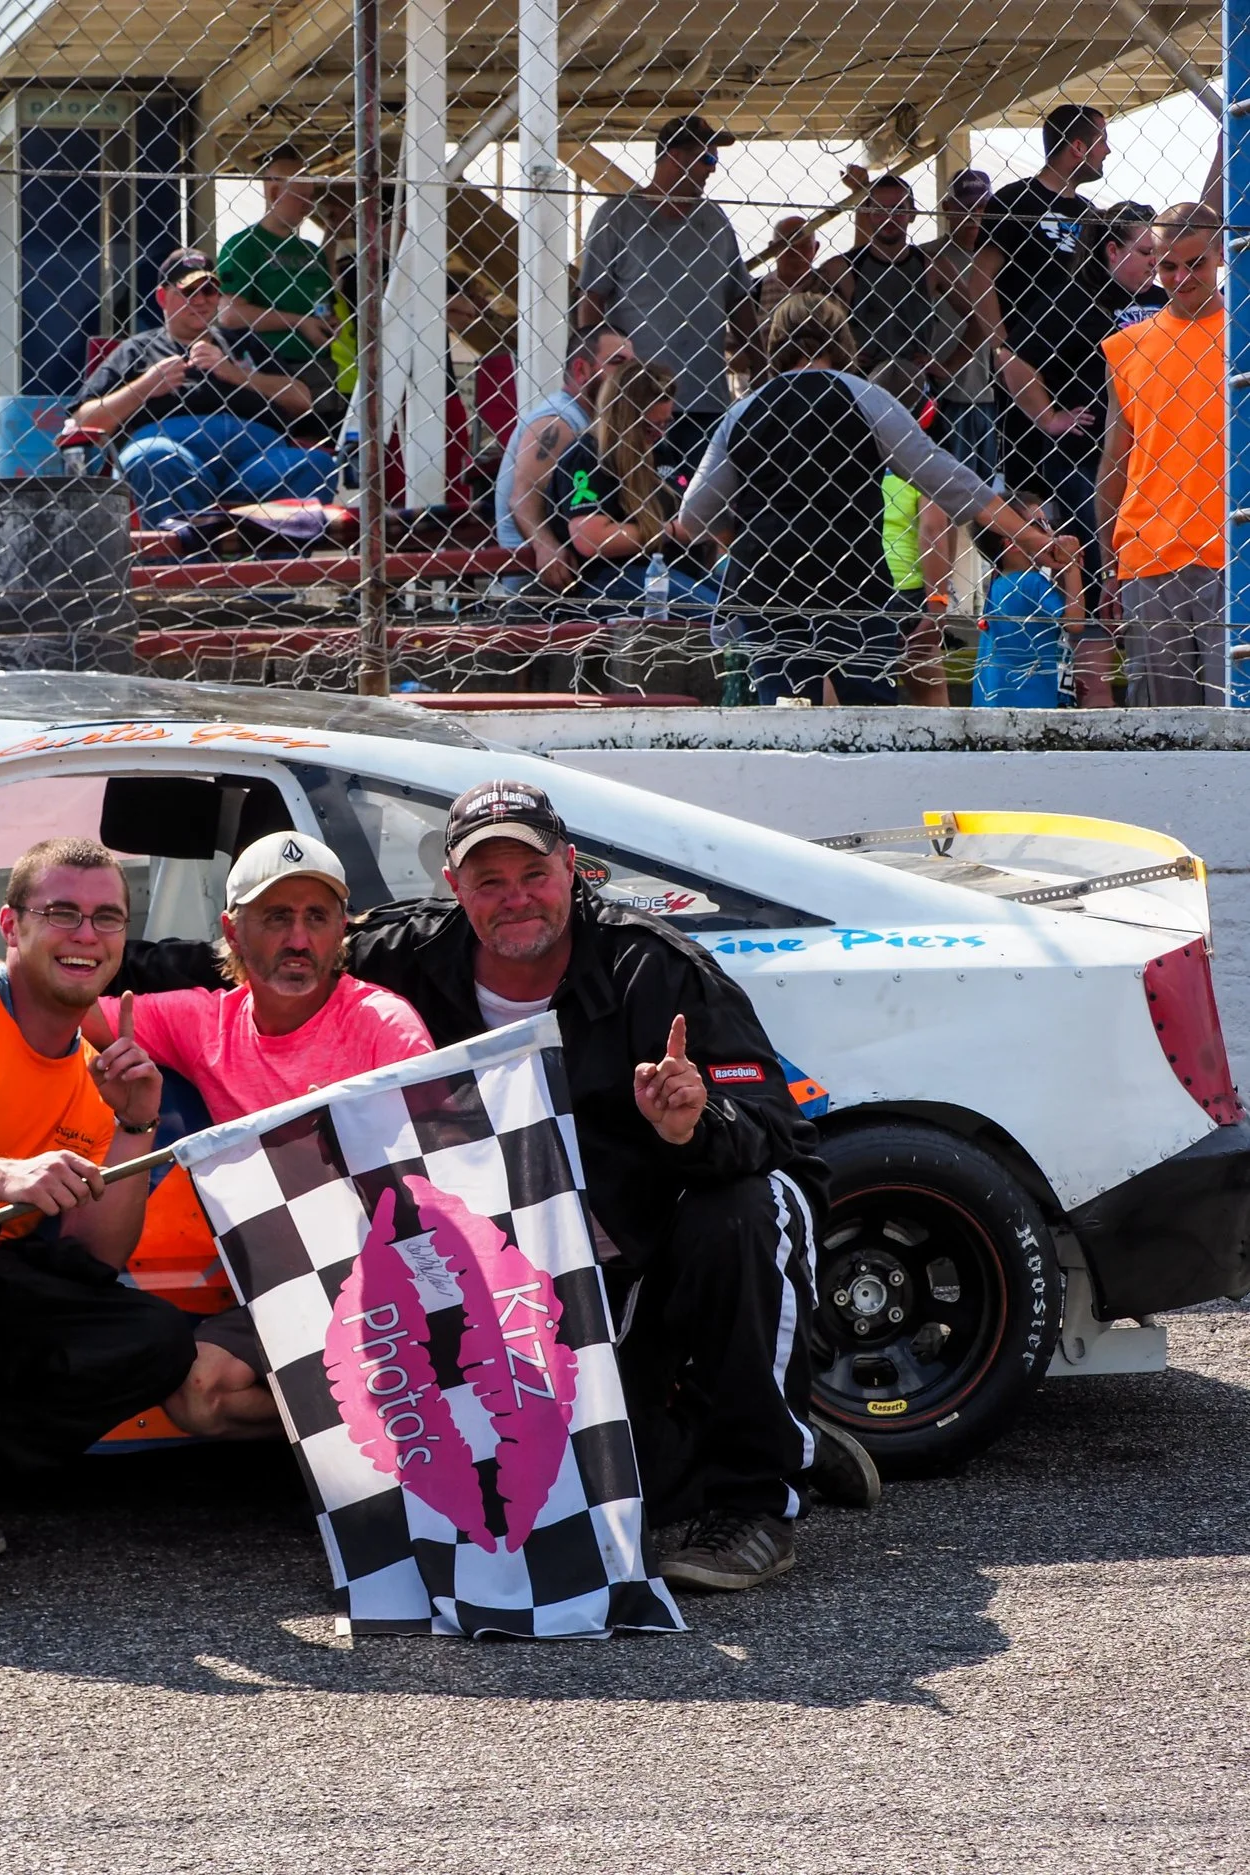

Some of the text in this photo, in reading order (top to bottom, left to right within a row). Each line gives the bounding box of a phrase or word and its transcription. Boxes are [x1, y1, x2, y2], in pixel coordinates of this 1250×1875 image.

[688, 928, 986, 955] ine Piers
[714, 1067, 758, 1079] RaceQuip
